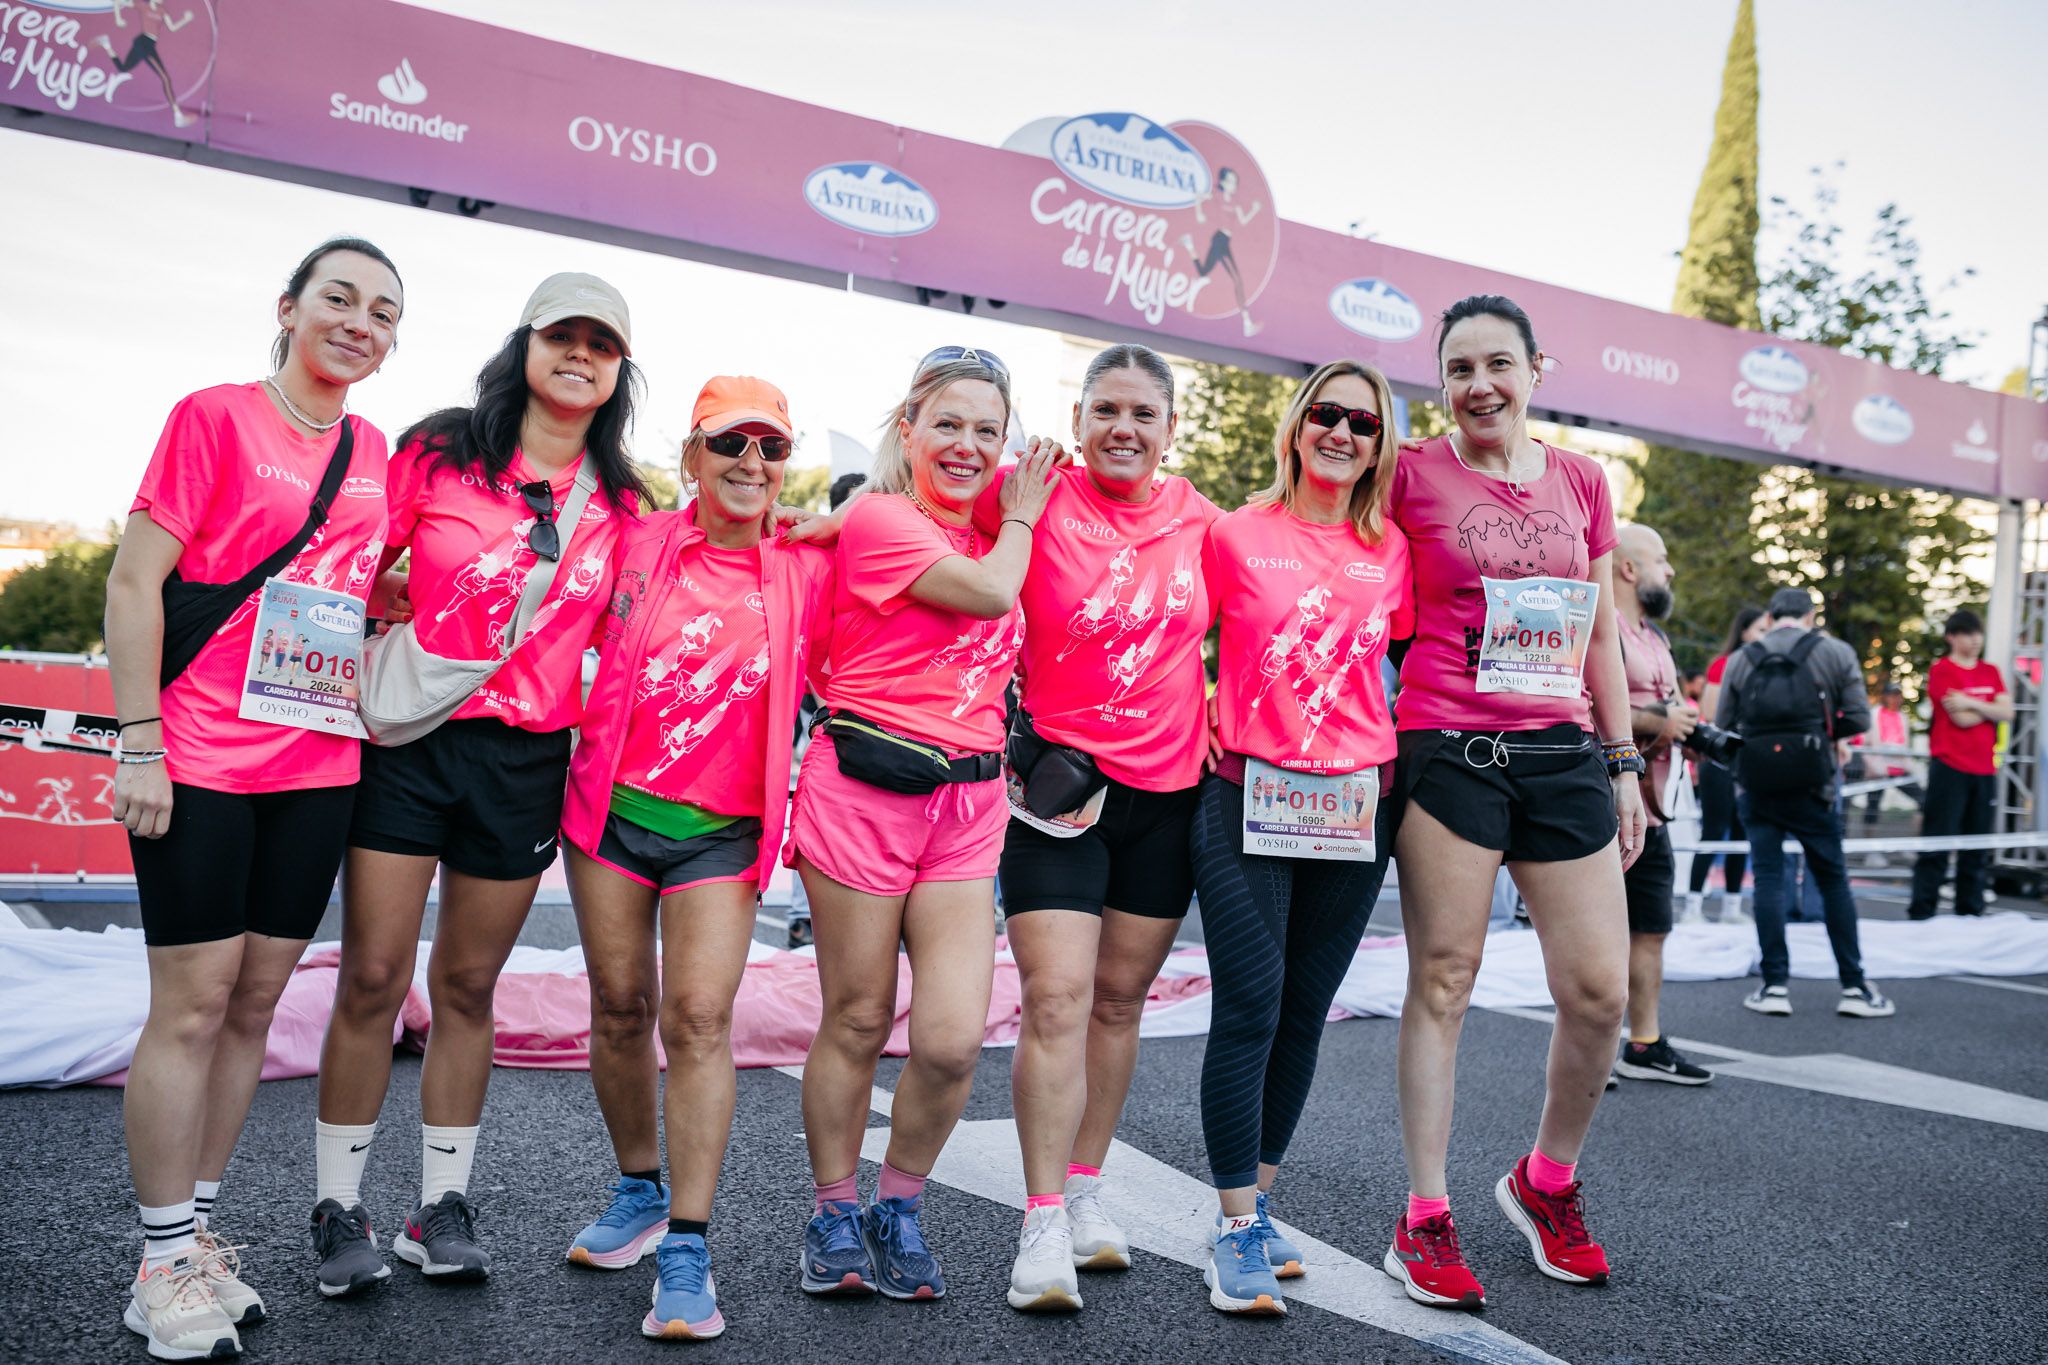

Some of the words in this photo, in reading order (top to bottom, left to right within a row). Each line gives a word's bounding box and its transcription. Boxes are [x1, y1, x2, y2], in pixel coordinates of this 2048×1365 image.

[0, 2, 79, 48] rera
[9, 38, 133, 111] Mujer
[329, 92, 469, 143] Santander
[568, 116, 718, 176] OYSHO
[1064, 132, 1197, 194] ASTURIANA
[816, 179, 925, 223] ASTURIANA
[1030, 178, 1168, 251] Carrera
[1062, 236, 1090, 268] de
[1093, 240, 1114, 275] la
[1104, 243, 1211, 325] Mujer
[1602, 346, 1680, 385] OYSHO
[461, 473, 521, 498] OYHO
[1063, 517, 1117, 541] OYSHO
[1246, 556, 1303, 571] OYSHO
[1518, 629, 1562, 650] 016
[304, 651, 356, 680] 016
[1490, 661, 1518, 670] CARRERA
[1524, 653, 1551, 662] 12218
[309, 680, 343, 695] 20244
[1488, 675, 1529, 686] OYSHO
[263, 685, 298, 698] CARRERA
[300, 692, 311, 700] DE
[312, 694, 322, 703] LA
[322, 695, 348, 707] MUJER
[259, 701, 309, 719] OYSHO
[1100, 713, 1117, 723] 2024
[1104, 704, 1114, 713] DE
[1115, 707, 1124, 716] LA
[1124, 708, 1148, 719] MUJER
[1281, 760, 1311, 769] CARRERA
[1312, 760, 1322, 769] DE
[1323, 759, 1332, 769] LA
[1333, 758, 1355, 768] MUJER
[1289, 790, 1338, 811] 016
[1259, 823, 1288, 832] CARRERA
[1290, 825, 1298, 833] DE
[1300, 826, 1309, 834] LA
[1310, 827, 1331, 836] MUJER
[1336, 829, 1360, 838] MADRID
[1296, 815, 1326, 825] 16905
[1257, 837, 1299, 850] OYSHO
[1323, 843, 1362, 853] Santander
[173, 1256, 189, 1268] NIKE
